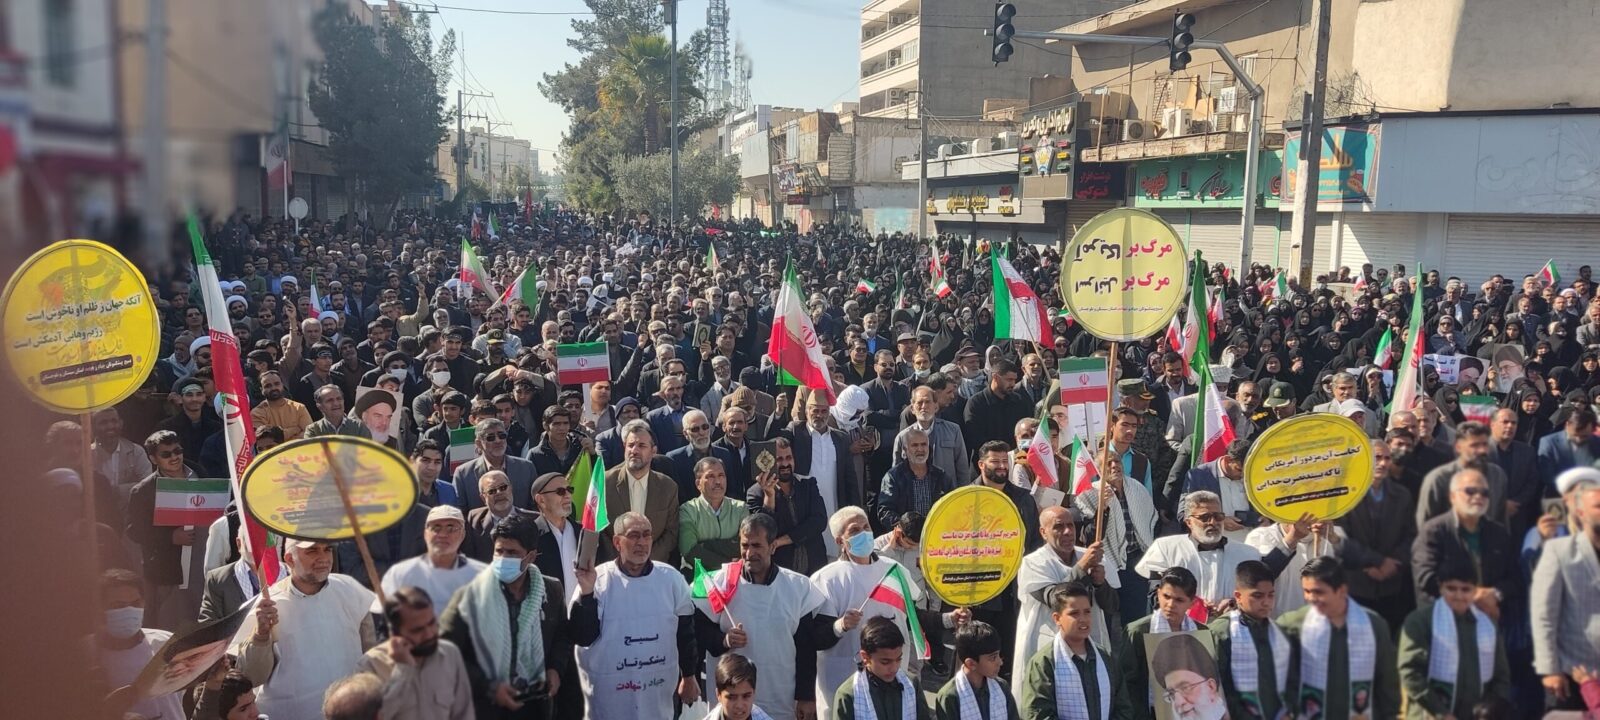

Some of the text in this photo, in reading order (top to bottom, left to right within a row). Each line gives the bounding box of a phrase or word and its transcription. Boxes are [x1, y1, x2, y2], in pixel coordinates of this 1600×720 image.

[1072, 238, 1172, 262] مرگ بر آمریکا
[1076, 272, 1170, 294] مرگ بر اسرائیل
[26, 294, 142, 322] آنکه جهان ز ظلم او ناخوش است
[64, 330, 86, 342] وهابی
[86, 326, 102, 338] رژیم
[14, 338, 31, 349] است
[1322, 450, 1332, 460] آن
[1334, 446, 1361, 457] کجاست
[1300, 456, 1321, 464] مزدور
[1325, 468, 1334, 477] که
[616, 656, 666, 670] پیشکسوتان
[616, 680, 642, 692] شهادت
[648, 678, 664, 687] جهاد
